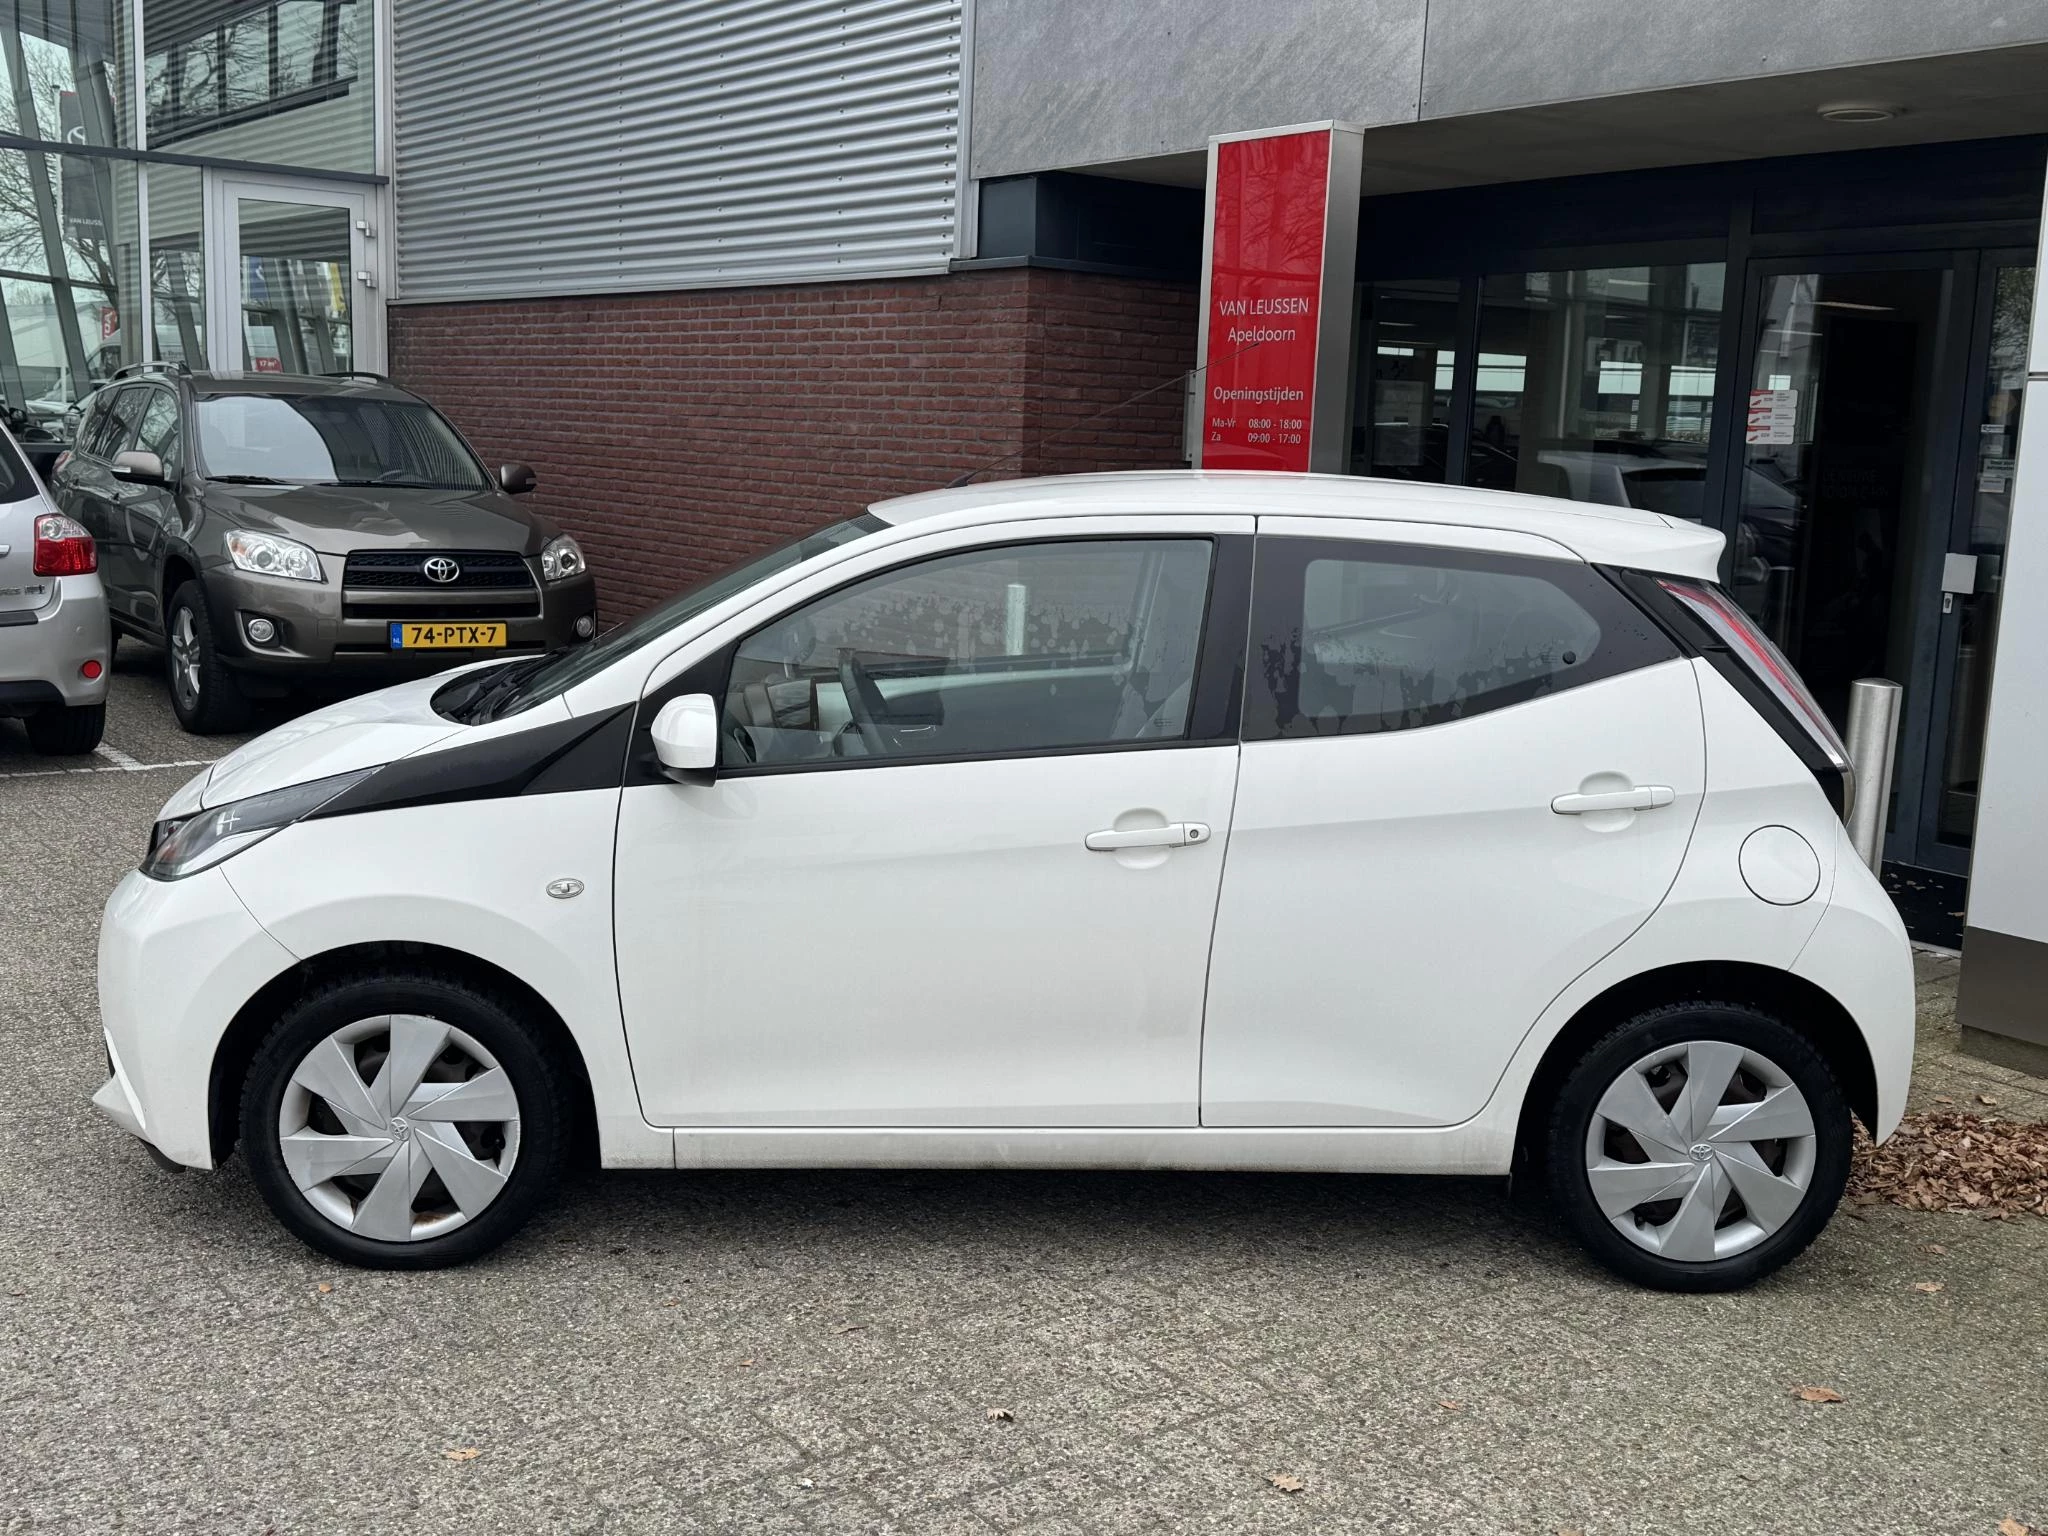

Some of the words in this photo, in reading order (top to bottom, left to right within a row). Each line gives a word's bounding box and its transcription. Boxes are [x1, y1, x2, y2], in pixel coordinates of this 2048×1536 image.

[1219, 300, 1246, 316] VAN
[1249, 297, 1309, 315] LEUSSEN
[1228, 326, 1296, 345] Apeldoorn
[1213, 386, 1304, 405] Openingstijden
[1212, 418, 1236, 428] Ma-Vr
[1248, 418, 1271, 429] 08:00
[1279, 419, 1302, 430] 18:00
[1211, 431, 1221, 441] Za
[1247, 432, 1270, 443] 09:00
[1279, 433, 1301, 444] 17:00
[411, 626, 497, 644] 74-PTX-7
